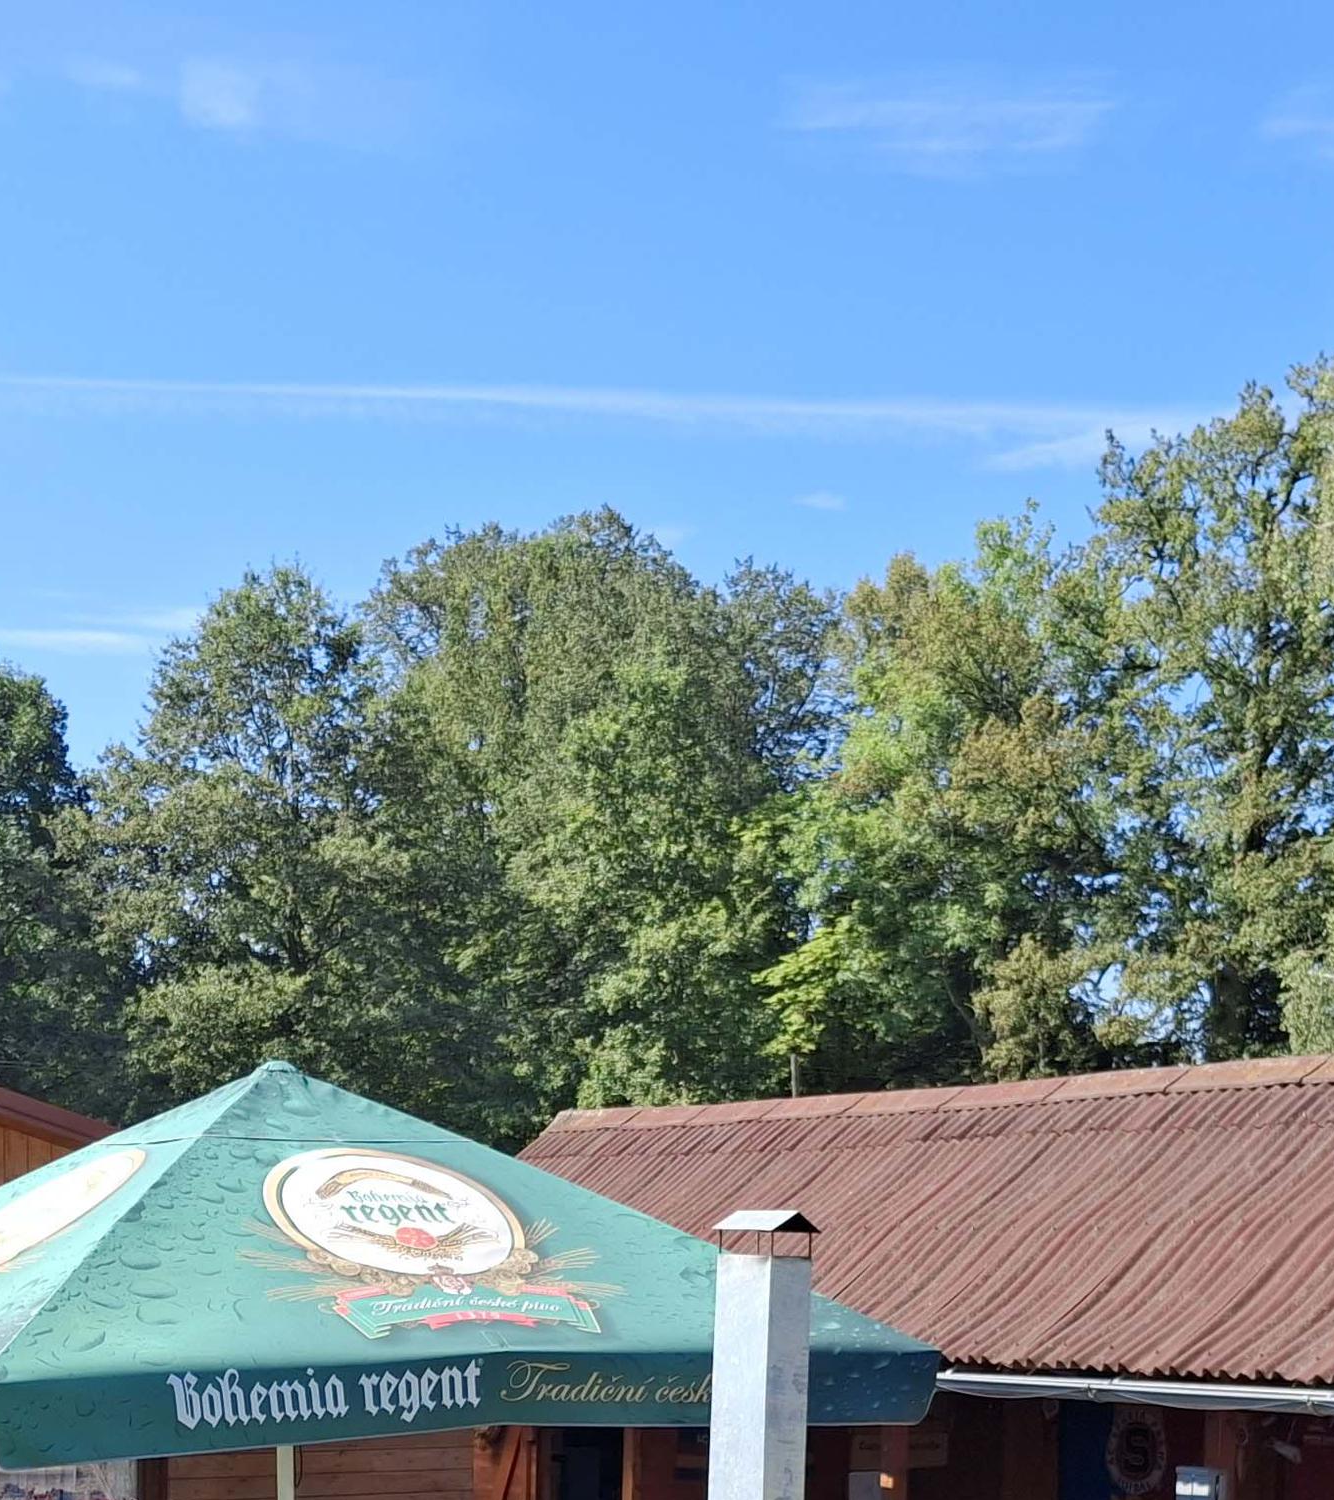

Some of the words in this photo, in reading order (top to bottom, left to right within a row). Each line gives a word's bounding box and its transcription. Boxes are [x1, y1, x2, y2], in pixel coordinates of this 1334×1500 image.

[339, 1202, 455, 1226] regent
[166, 1367, 350, 1431] Bohemia
[358, 1358, 482, 1424] regent
[500, 1359, 655, 1404] Tradiční
[655, 1371, 712, 1405] česk
